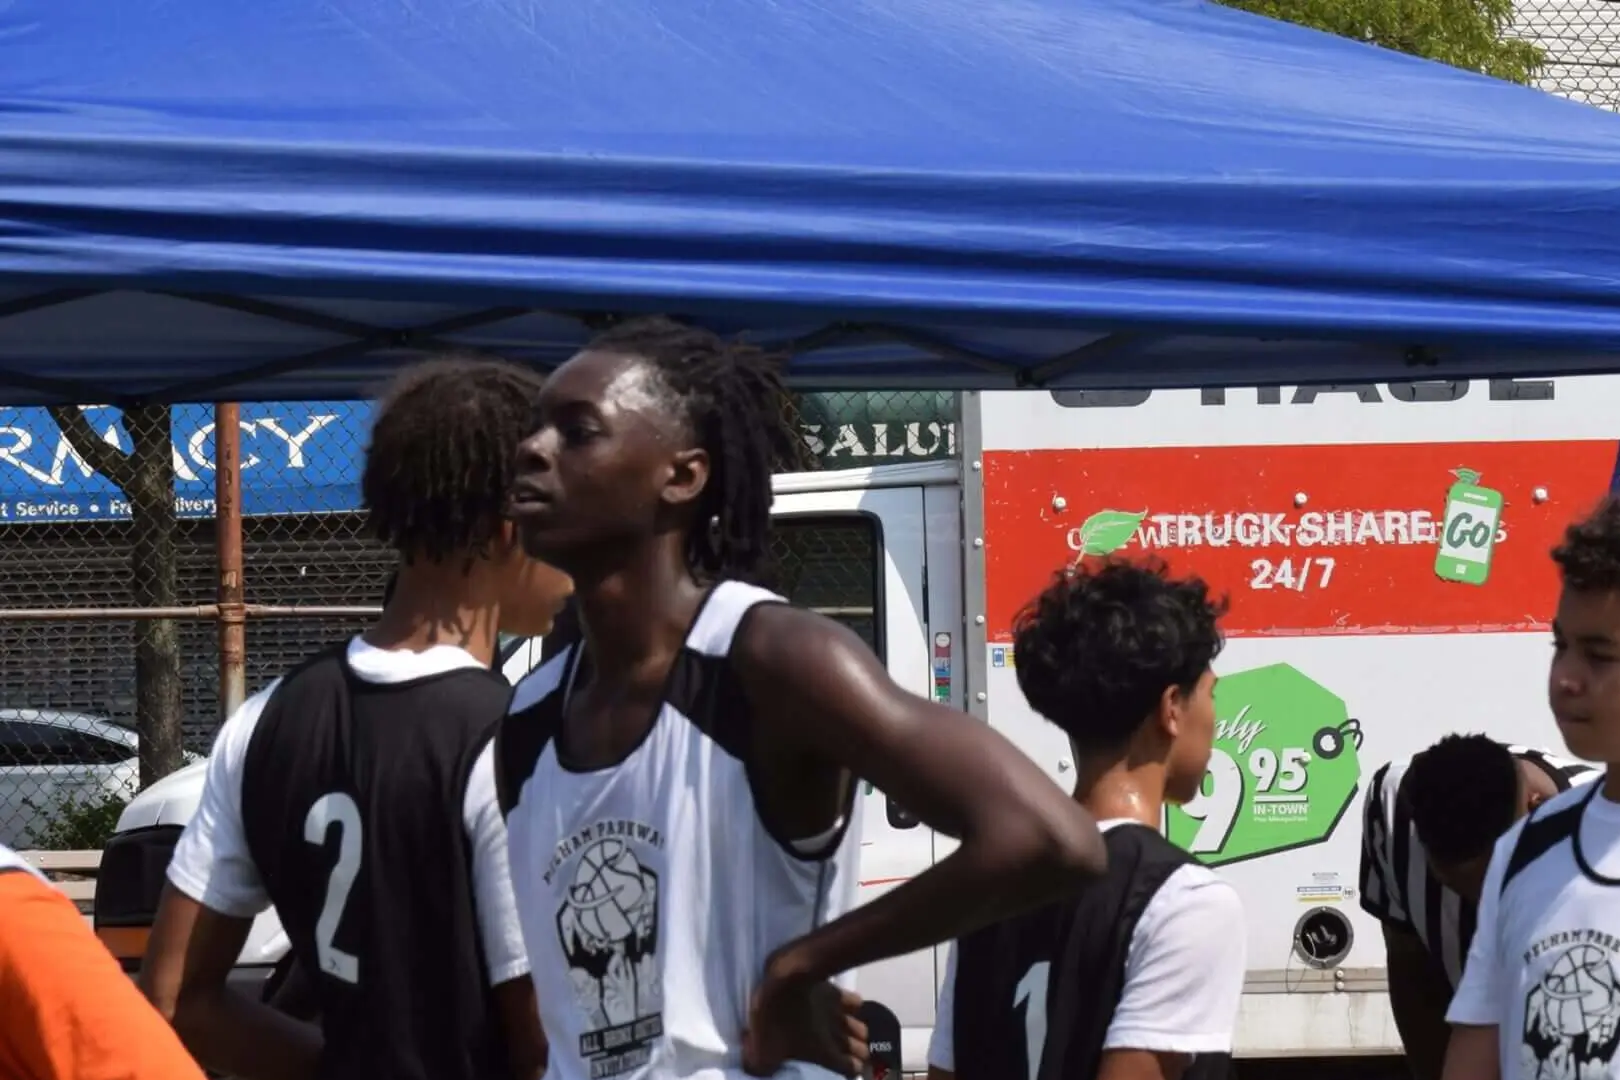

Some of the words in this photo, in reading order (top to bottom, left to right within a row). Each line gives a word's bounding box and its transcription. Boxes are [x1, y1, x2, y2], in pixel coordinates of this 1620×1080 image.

[16, 501, 80, 517] Service
[1151, 513, 1288, 547] TRUCK
[1299, 510, 1433, 544] SHARE
[1250, 555, 1336, 592] 24/7
[1254, 803, 1308, 815] IN-TOWN
[304, 791, 363, 983] 2
